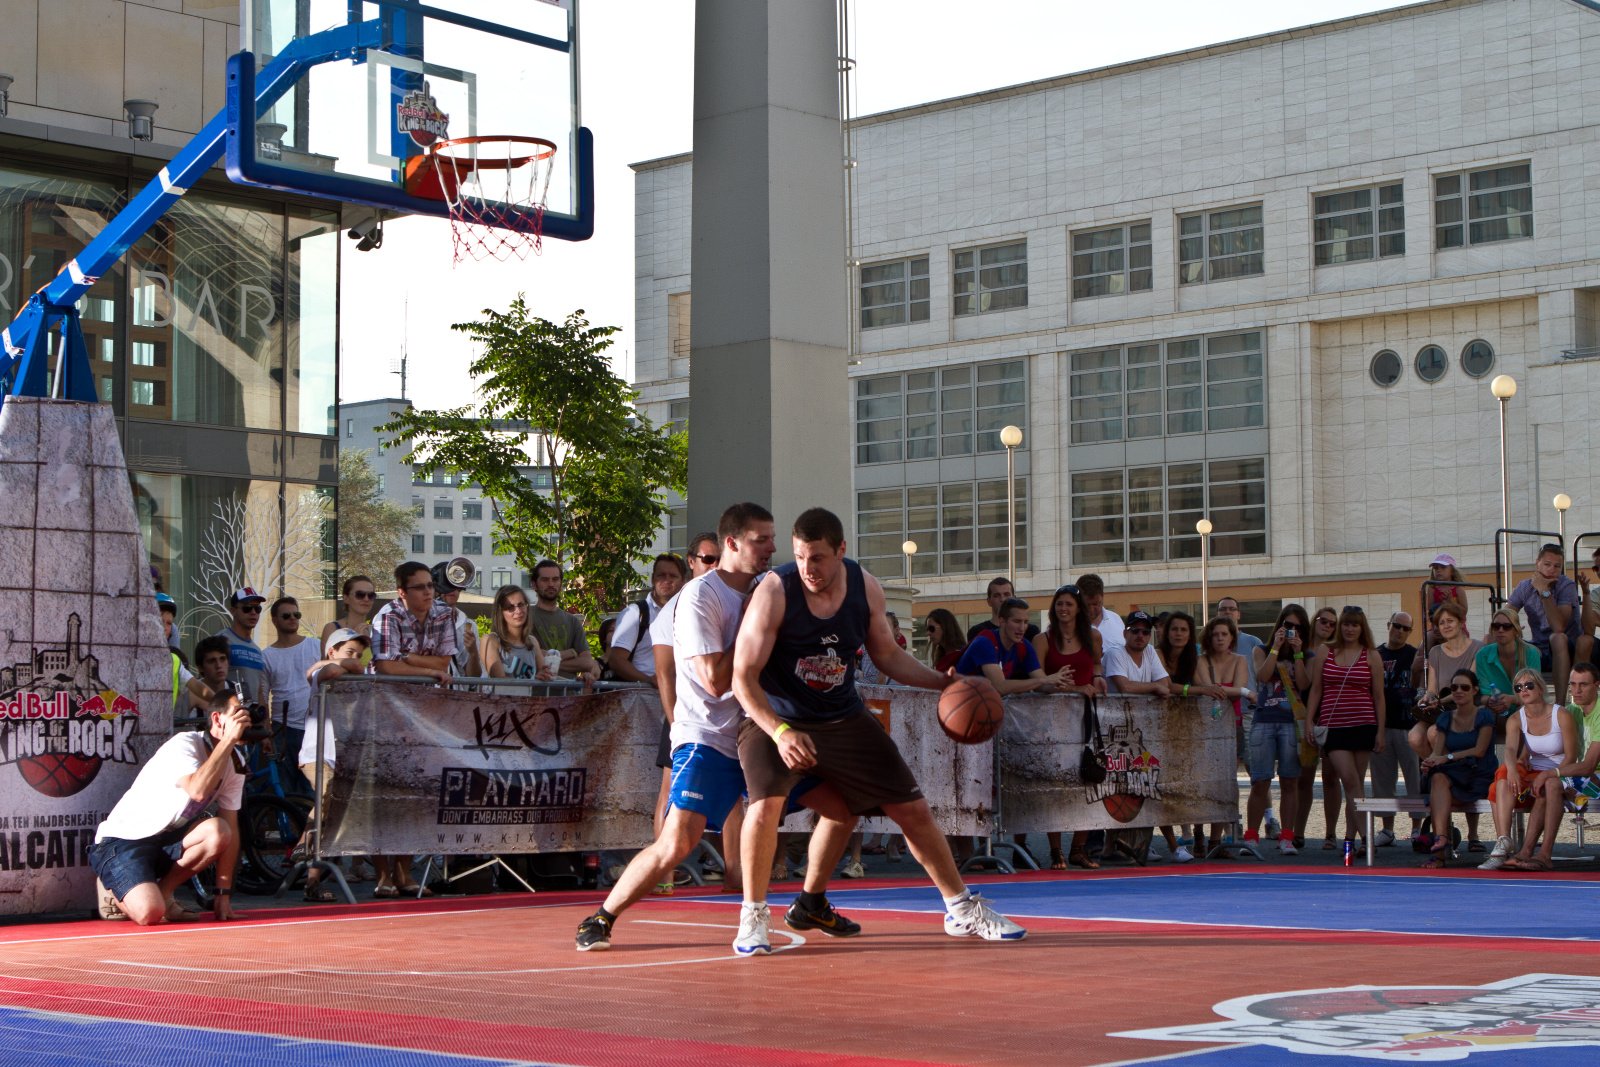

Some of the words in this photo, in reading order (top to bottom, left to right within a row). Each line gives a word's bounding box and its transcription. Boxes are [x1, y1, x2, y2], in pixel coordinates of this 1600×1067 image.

[140, 269, 276, 338] BAR
[26, 691, 69, 719] Bull
[49, 719, 64, 736] OF
[68, 715, 138, 764] ROCK
[46, 735, 68, 753] THE
[1105, 752, 1127, 772] Bull
[444, 770, 513, 806] PLAY
[518, 771, 583, 806] HARD
[1126, 767, 1162, 801] ROCK
[442, 811, 468, 824] DON'T
[473, 811, 523, 824] EMBARRASS
[526, 811, 541, 823] OUR
